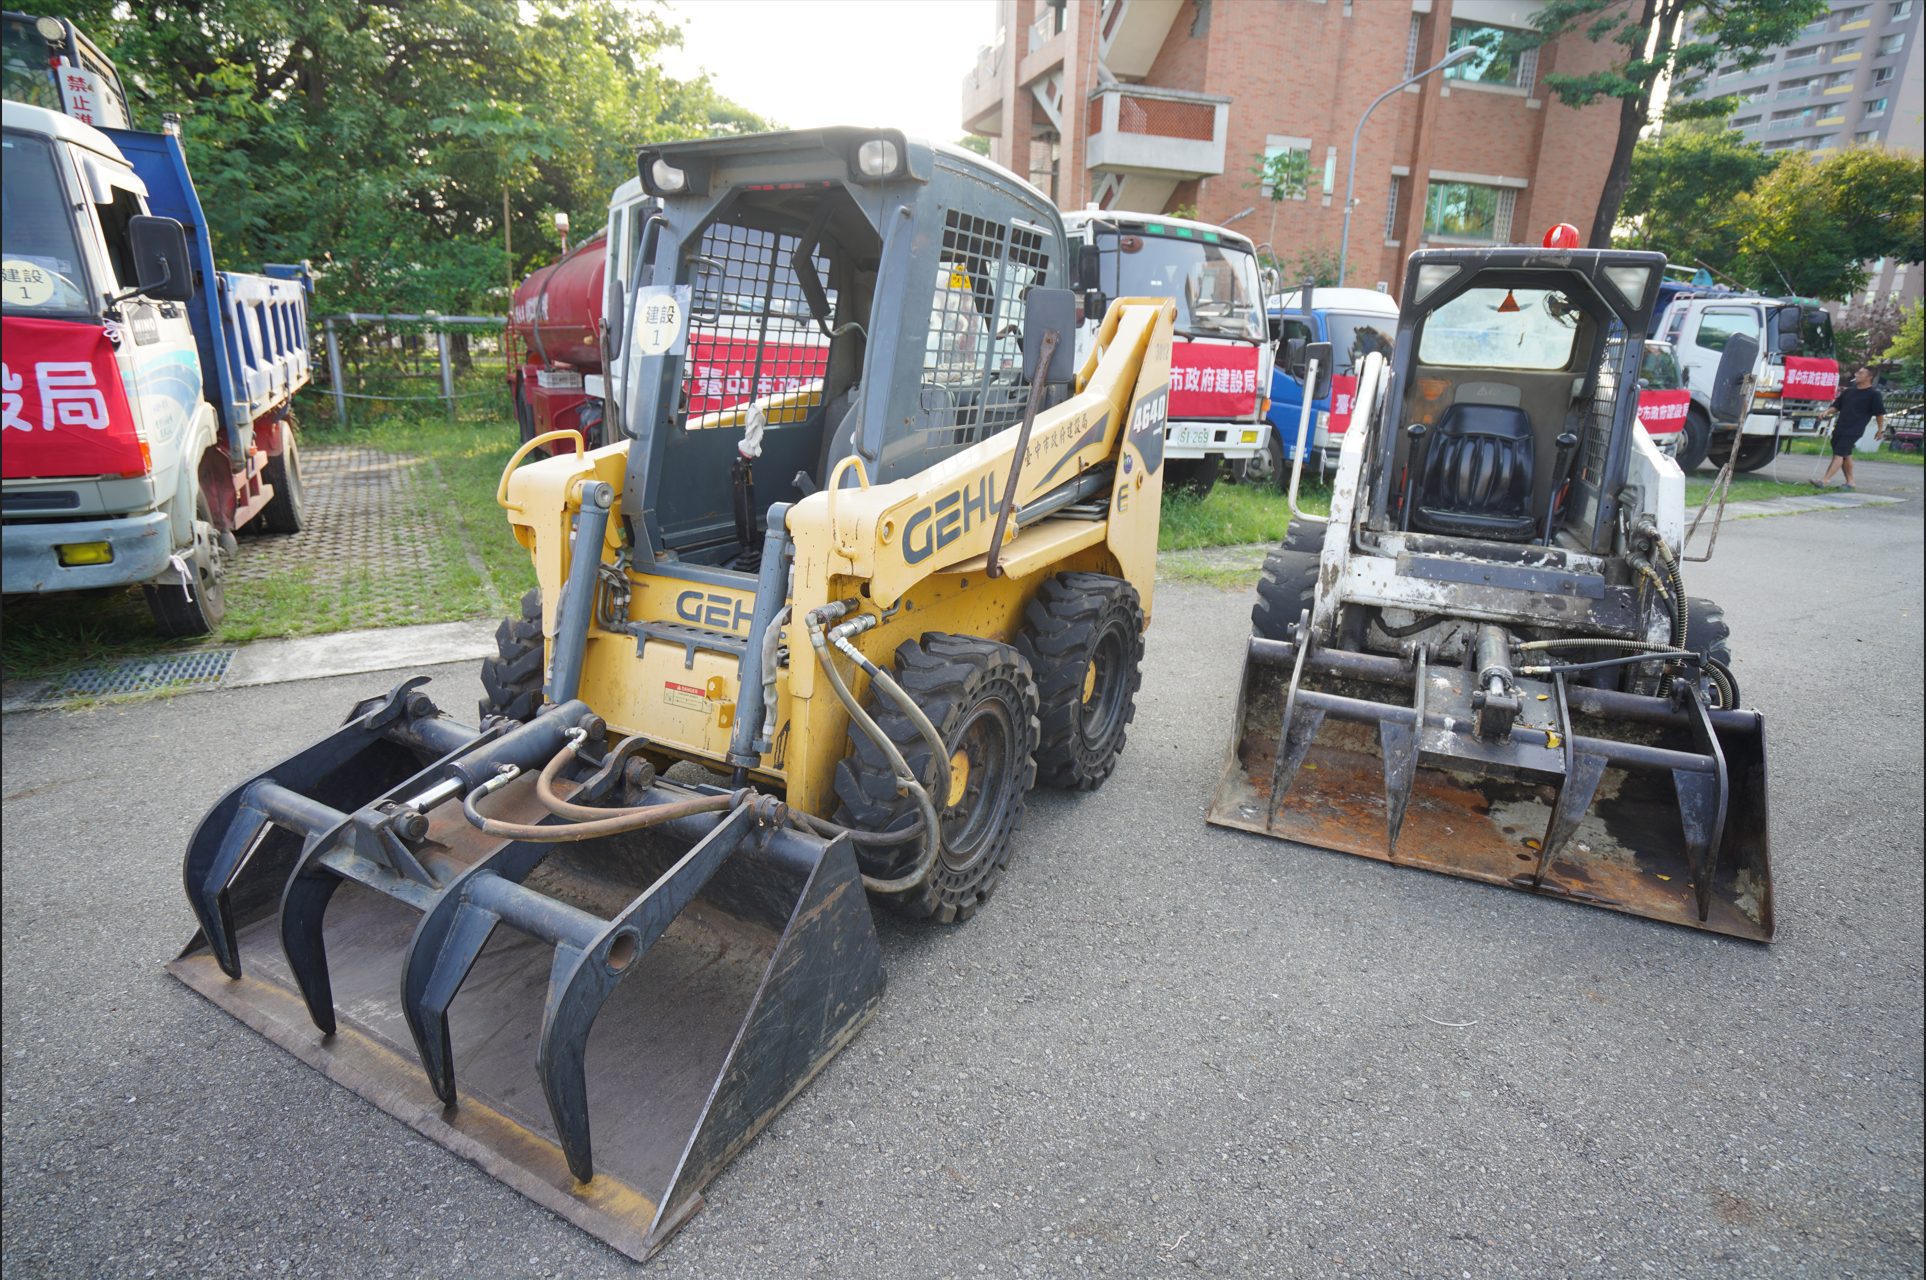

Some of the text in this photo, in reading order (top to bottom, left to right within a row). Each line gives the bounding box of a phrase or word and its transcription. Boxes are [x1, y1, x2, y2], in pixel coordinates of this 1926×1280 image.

[2, 268, 44, 284] 建設
[20, 286, 33, 300] 1
[645, 304, 676, 325] 建設
[651, 329, 660, 346] 1
[1169, 366, 1256, 394] 市政府建設局
[1132, 394, 1167, 433] 4640
[1024, 412, 1088, 468] 臺中市政府建設局
[676, 590, 753, 631] GEH
